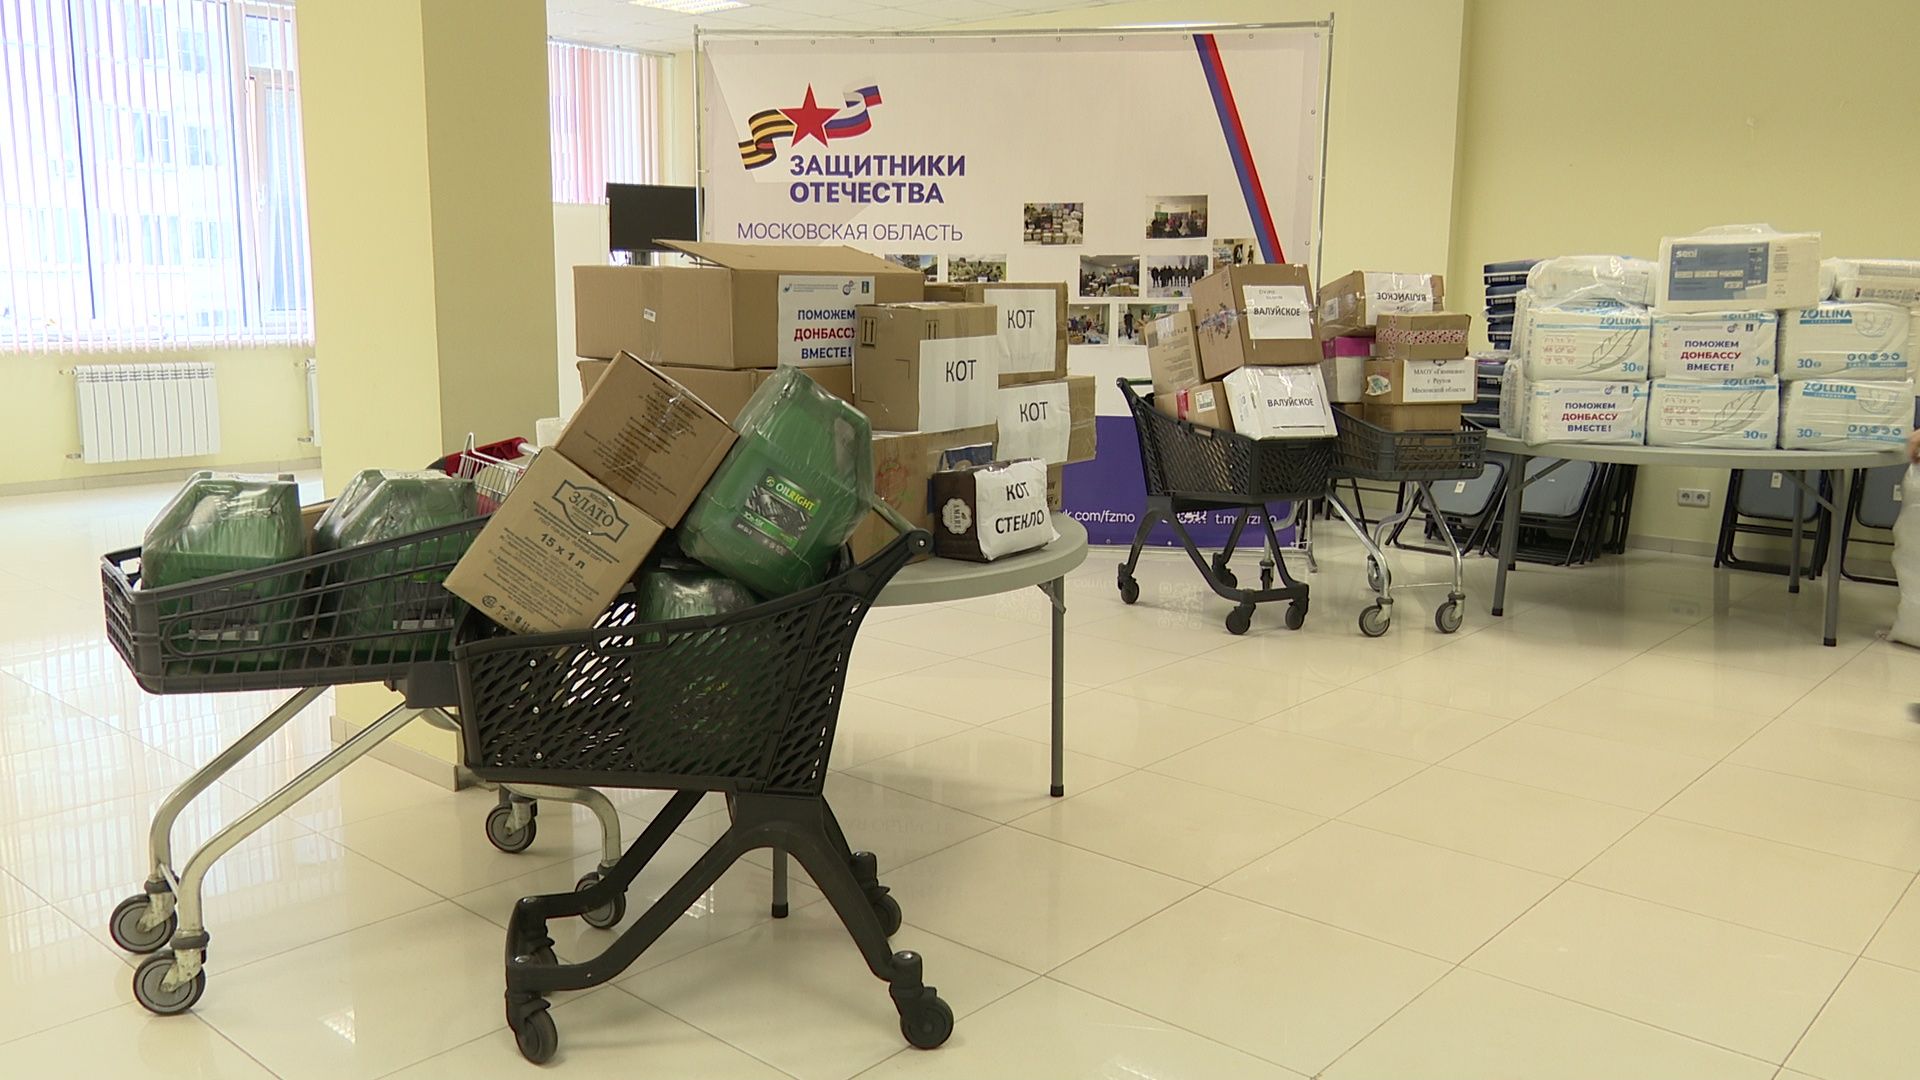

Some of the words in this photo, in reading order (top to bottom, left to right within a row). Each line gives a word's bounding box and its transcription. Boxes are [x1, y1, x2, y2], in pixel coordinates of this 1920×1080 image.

[790, 155, 965, 178] ЗАЩИТНИКИ
[790, 182, 944, 203] ОТЕЧЕСТВА
[738, 223, 867, 240] МОСКОВСКАЯ
[873, 224, 963, 241] ОБЛАСТЬ
[798, 310, 855, 320] ПОМОЖЕМ
[1007, 310, 1035, 329] КОТ
[1253, 305, 1301, 316] ВАЛУЙСКОЕ
[1800, 309, 1852, 319] ZOLLINA
[1600, 317, 1642, 325] ZOLLINA
[801, 347, 852, 359] ВМЕСТЕ!
[1680, 352, 1741, 360] ДОНБАССУ
[946, 360, 977, 382] КОТ
[1686, 363, 1734, 371] ВМЕСТЕ!
[1803, 382, 1856, 393] ZOLLINA
[1267, 396, 1314, 407] ВАЛУЙСКОЕ
[1020, 402, 1048, 422] КОТ
[1561, 413, 1618, 421] ДОНБАССУ
[775, 483, 815, 511] OILRIGHT
[1006, 482, 1030, 501] КОТ
[568, 490, 615, 528] ЗЛАТО
[995, 510, 1044, 534] СТЕКЛО
[540, 532, 556, 547] 15
[567, 551, 575, 561] 1
[575, 560, 586, 570] л
